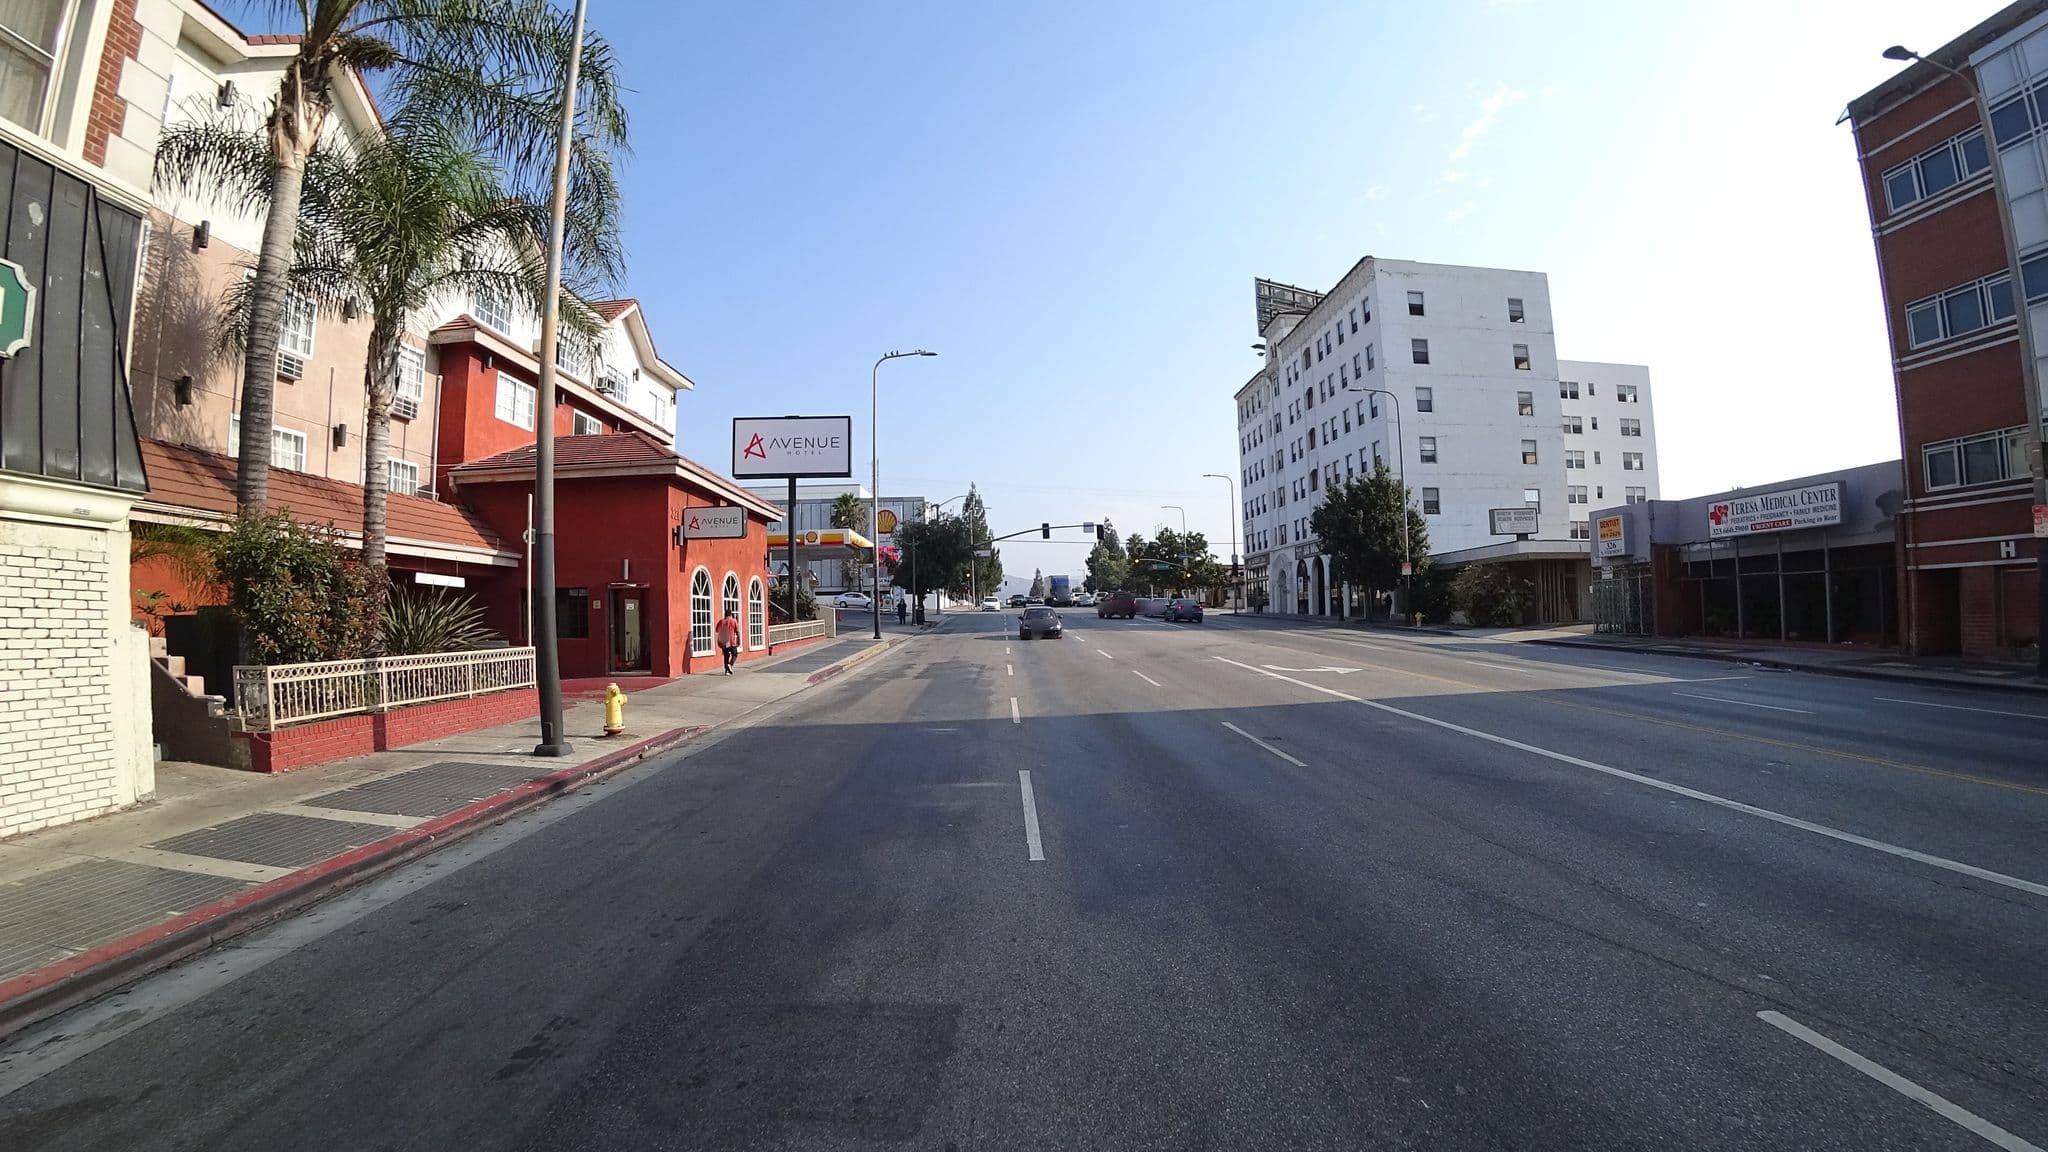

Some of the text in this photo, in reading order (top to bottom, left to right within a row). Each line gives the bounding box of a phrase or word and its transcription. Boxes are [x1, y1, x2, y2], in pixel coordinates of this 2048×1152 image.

[769, 436, 841, 449] AVENUE
[1729, 488, 1837, 516] TERESA MEDICAL CENTER
[1793, 507, 1810, 516] FAMILY
[1812, 504, 1837, 513] MEDICINE
[701, 517, 739, 525] AVENUE
[1600, 518, 1619, 529] DENTIST
[1752, 519, 1791, 530] URGENT CARE
[1794, 517, 1816, 526] Parking
[1823, 514, 1838, 522] Rear
[2000, 541, 2016, 558] H
